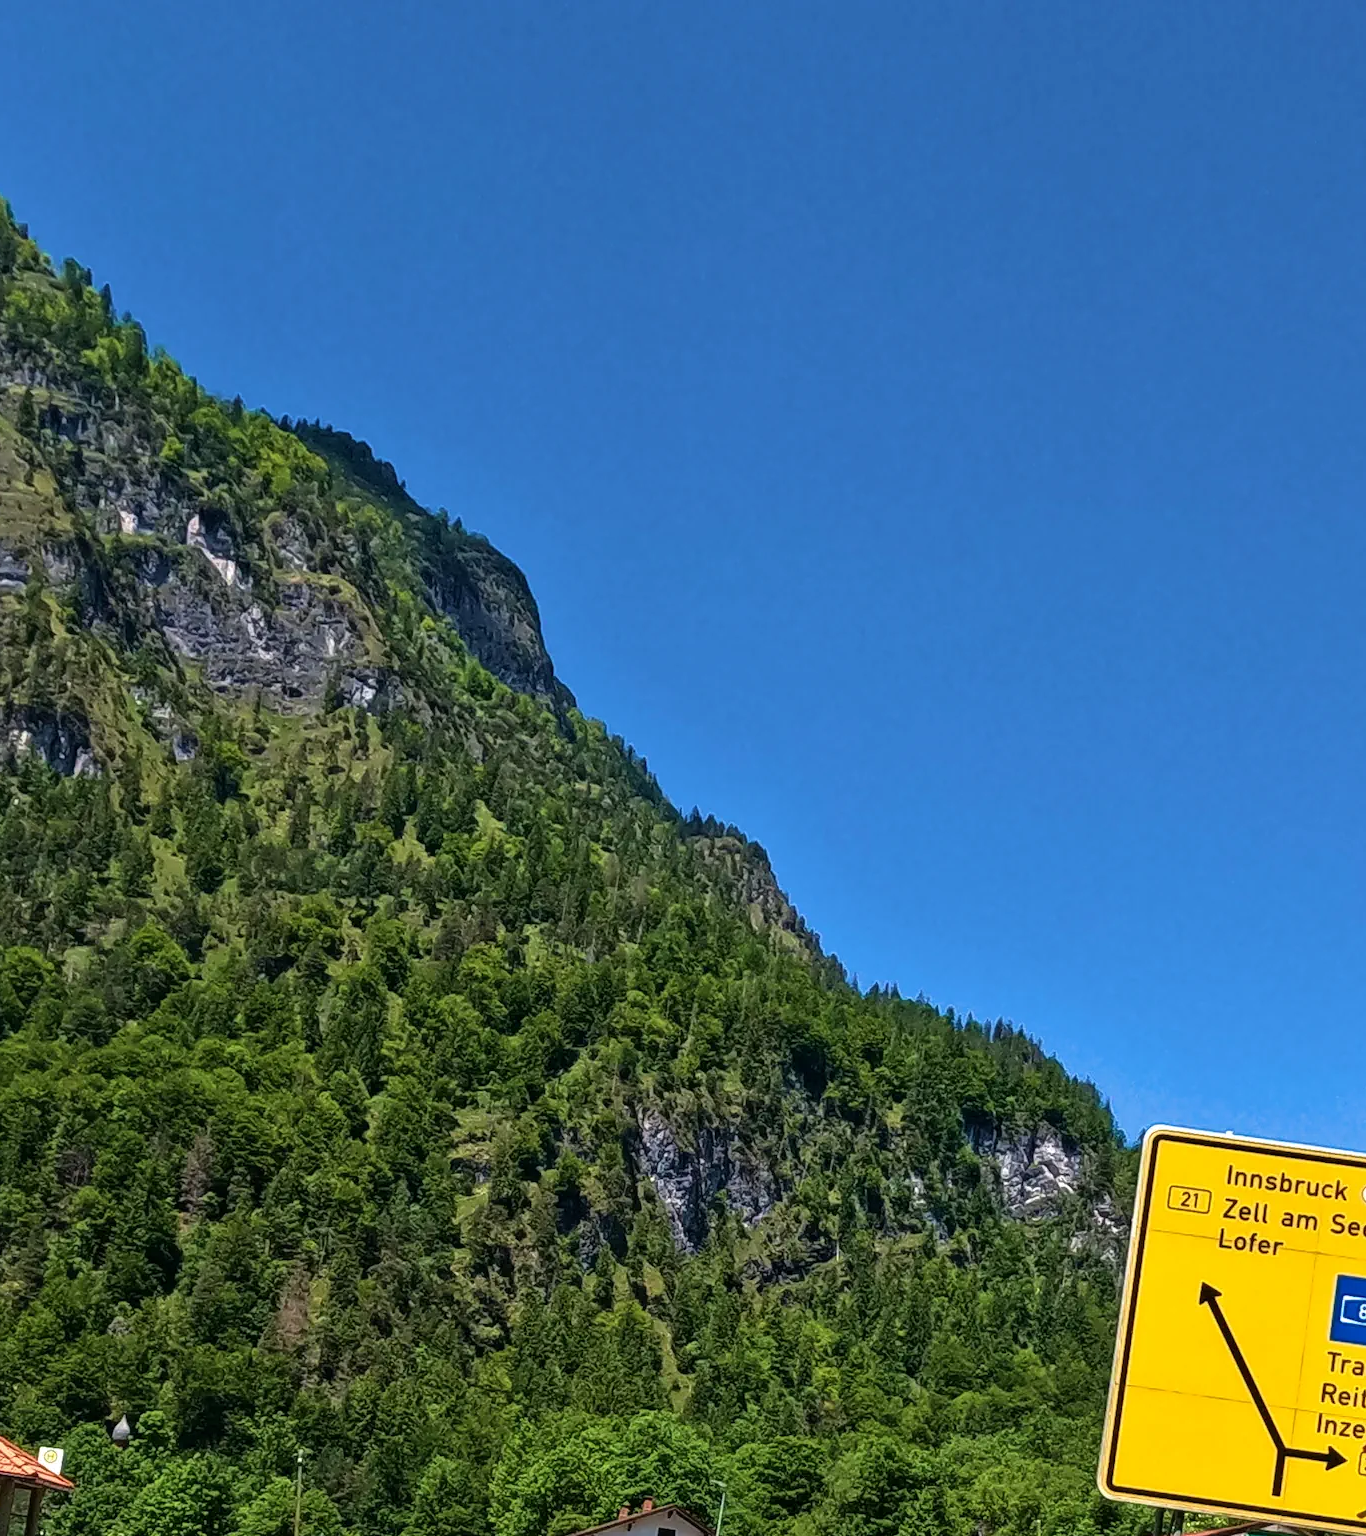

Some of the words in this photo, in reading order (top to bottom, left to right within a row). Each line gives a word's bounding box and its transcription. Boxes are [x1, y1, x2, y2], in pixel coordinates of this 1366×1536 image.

[1227, 1165, 1349, 1201] Innsbruck
[1180, 1191, 1199, 1209] 21
[1223, 1198, 1269, 1224] Zell
[1282, 1212, 1318, 1231] am
[1218, 1228, 1283, 1256] Lofer
